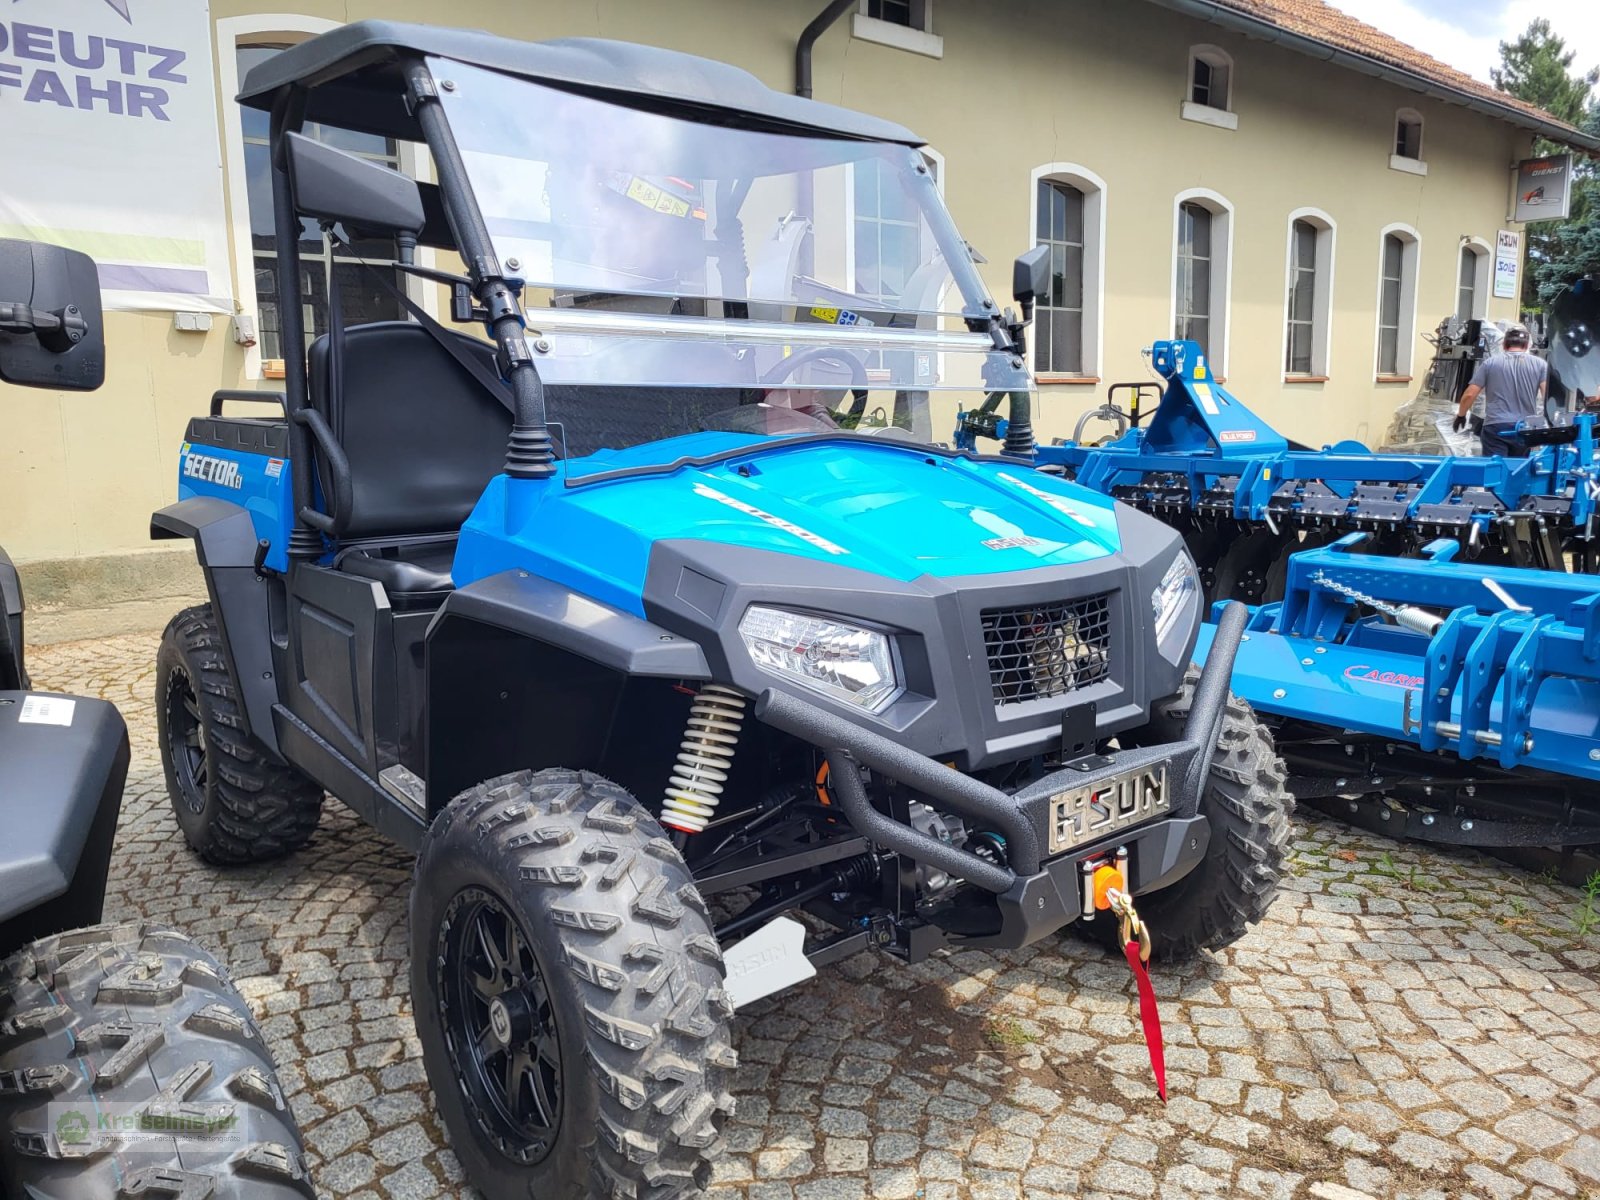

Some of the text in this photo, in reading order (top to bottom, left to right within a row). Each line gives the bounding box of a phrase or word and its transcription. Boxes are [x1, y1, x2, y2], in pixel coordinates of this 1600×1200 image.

[0, 21, 187, 84] EUTZ
[1532, 166, 1564, 177] DIENST
[1498, 232, 1518, 248] HSUN
[183, 453, 239, 488] SECTOR
[1056, 766, 1166, 844] HSUN
